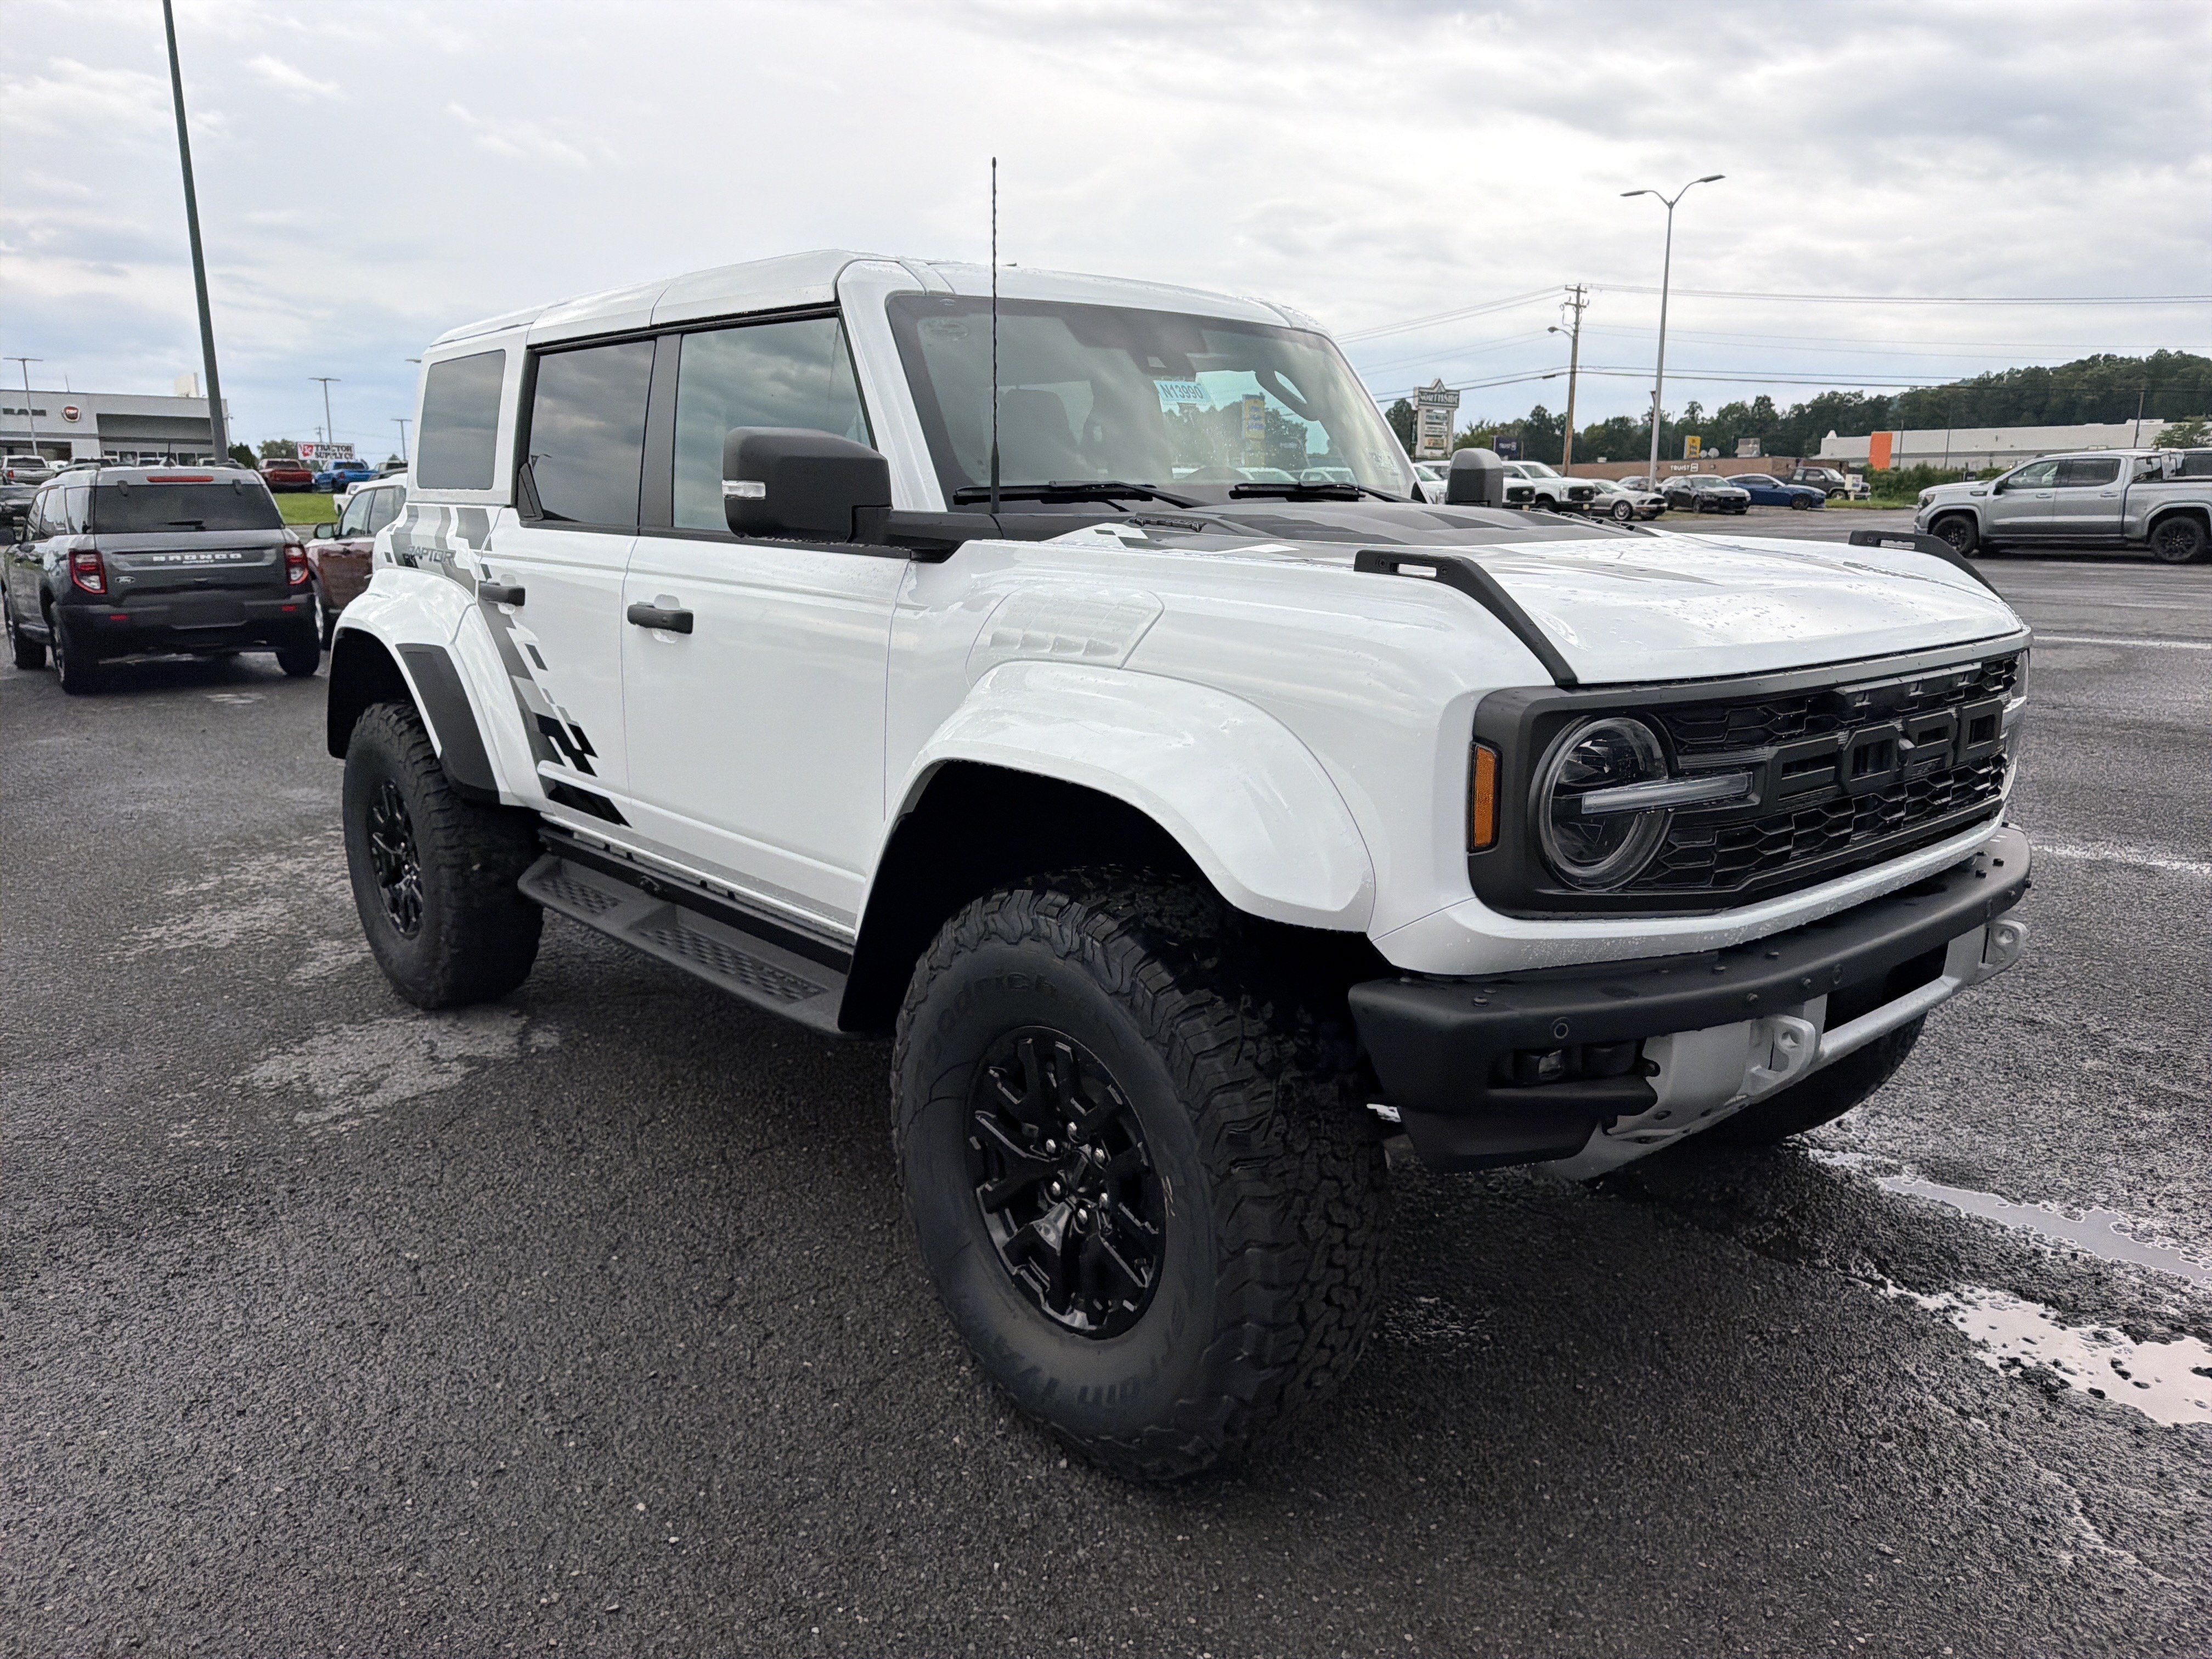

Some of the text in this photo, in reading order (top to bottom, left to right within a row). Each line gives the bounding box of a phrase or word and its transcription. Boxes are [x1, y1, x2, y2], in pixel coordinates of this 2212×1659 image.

[1159, 384, 1204, 399] N13990
[153, 553, 242, 562] BRONCO
[1768, 697, 2005, 812] FORD
